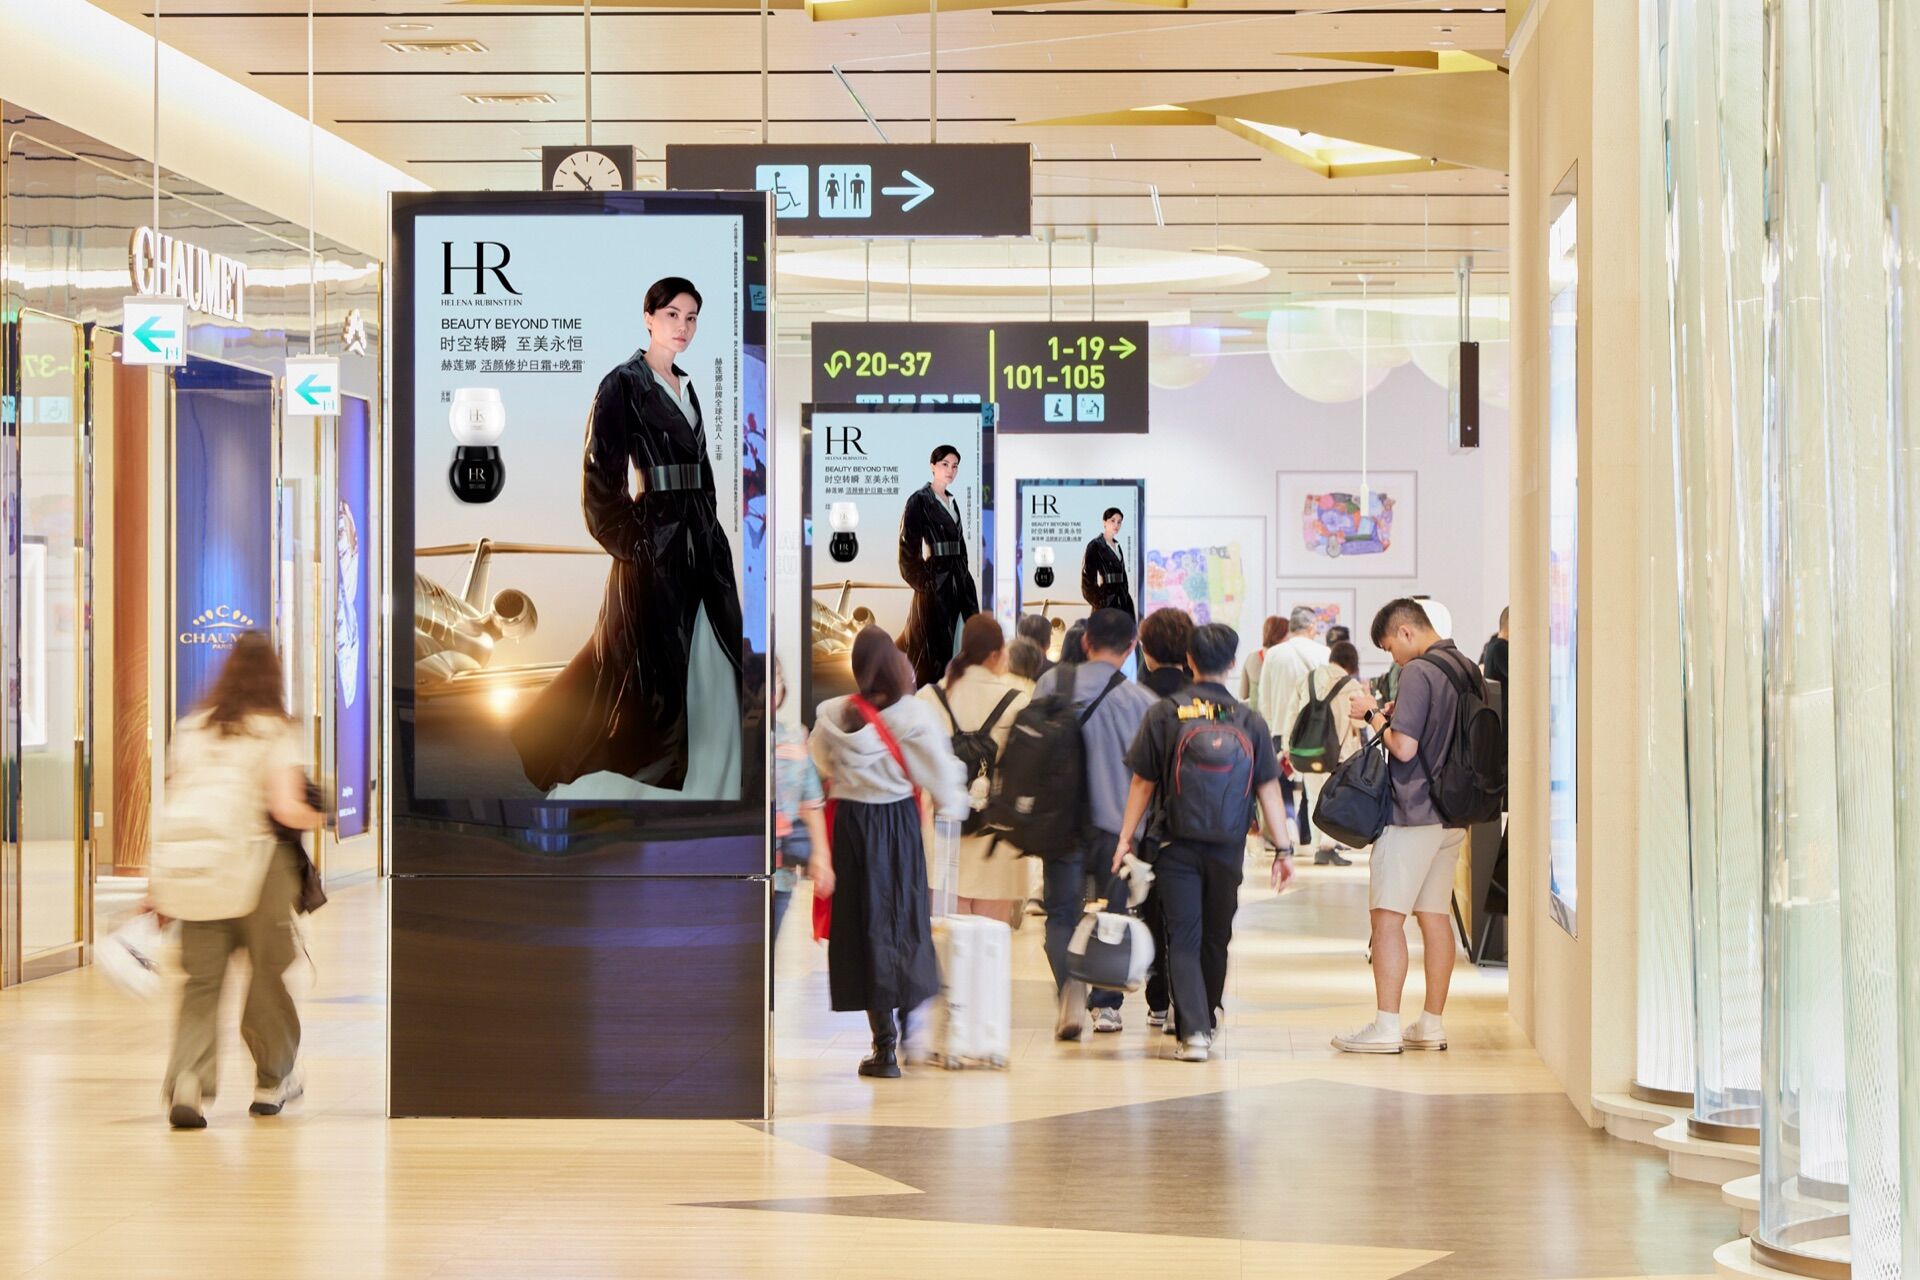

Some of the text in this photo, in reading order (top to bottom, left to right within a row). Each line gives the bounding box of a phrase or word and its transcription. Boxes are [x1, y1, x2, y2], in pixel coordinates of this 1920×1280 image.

[129, 226, 248, 323] CHAUMET
[441, 241, 523, 296] HR
[441, 299, 523, 307] HELENA RUBINSTEIN
[441, 318, 583, 330] BEAUTY BEYOND TIME
[440, 335, 584, 353] 时空转瞬 至美永恒
[1048, 336, 1105, 361] 1-19
[441, 359, 477, 372] 赫莲娜
[855, 352, 932, 376] 20-37
[1003, 365, 1105, 389] 101-105
[825, 426, 868, 456] HR
[469, 467, 486, 481] HR
[1032, 494, 1061, 515] HR
